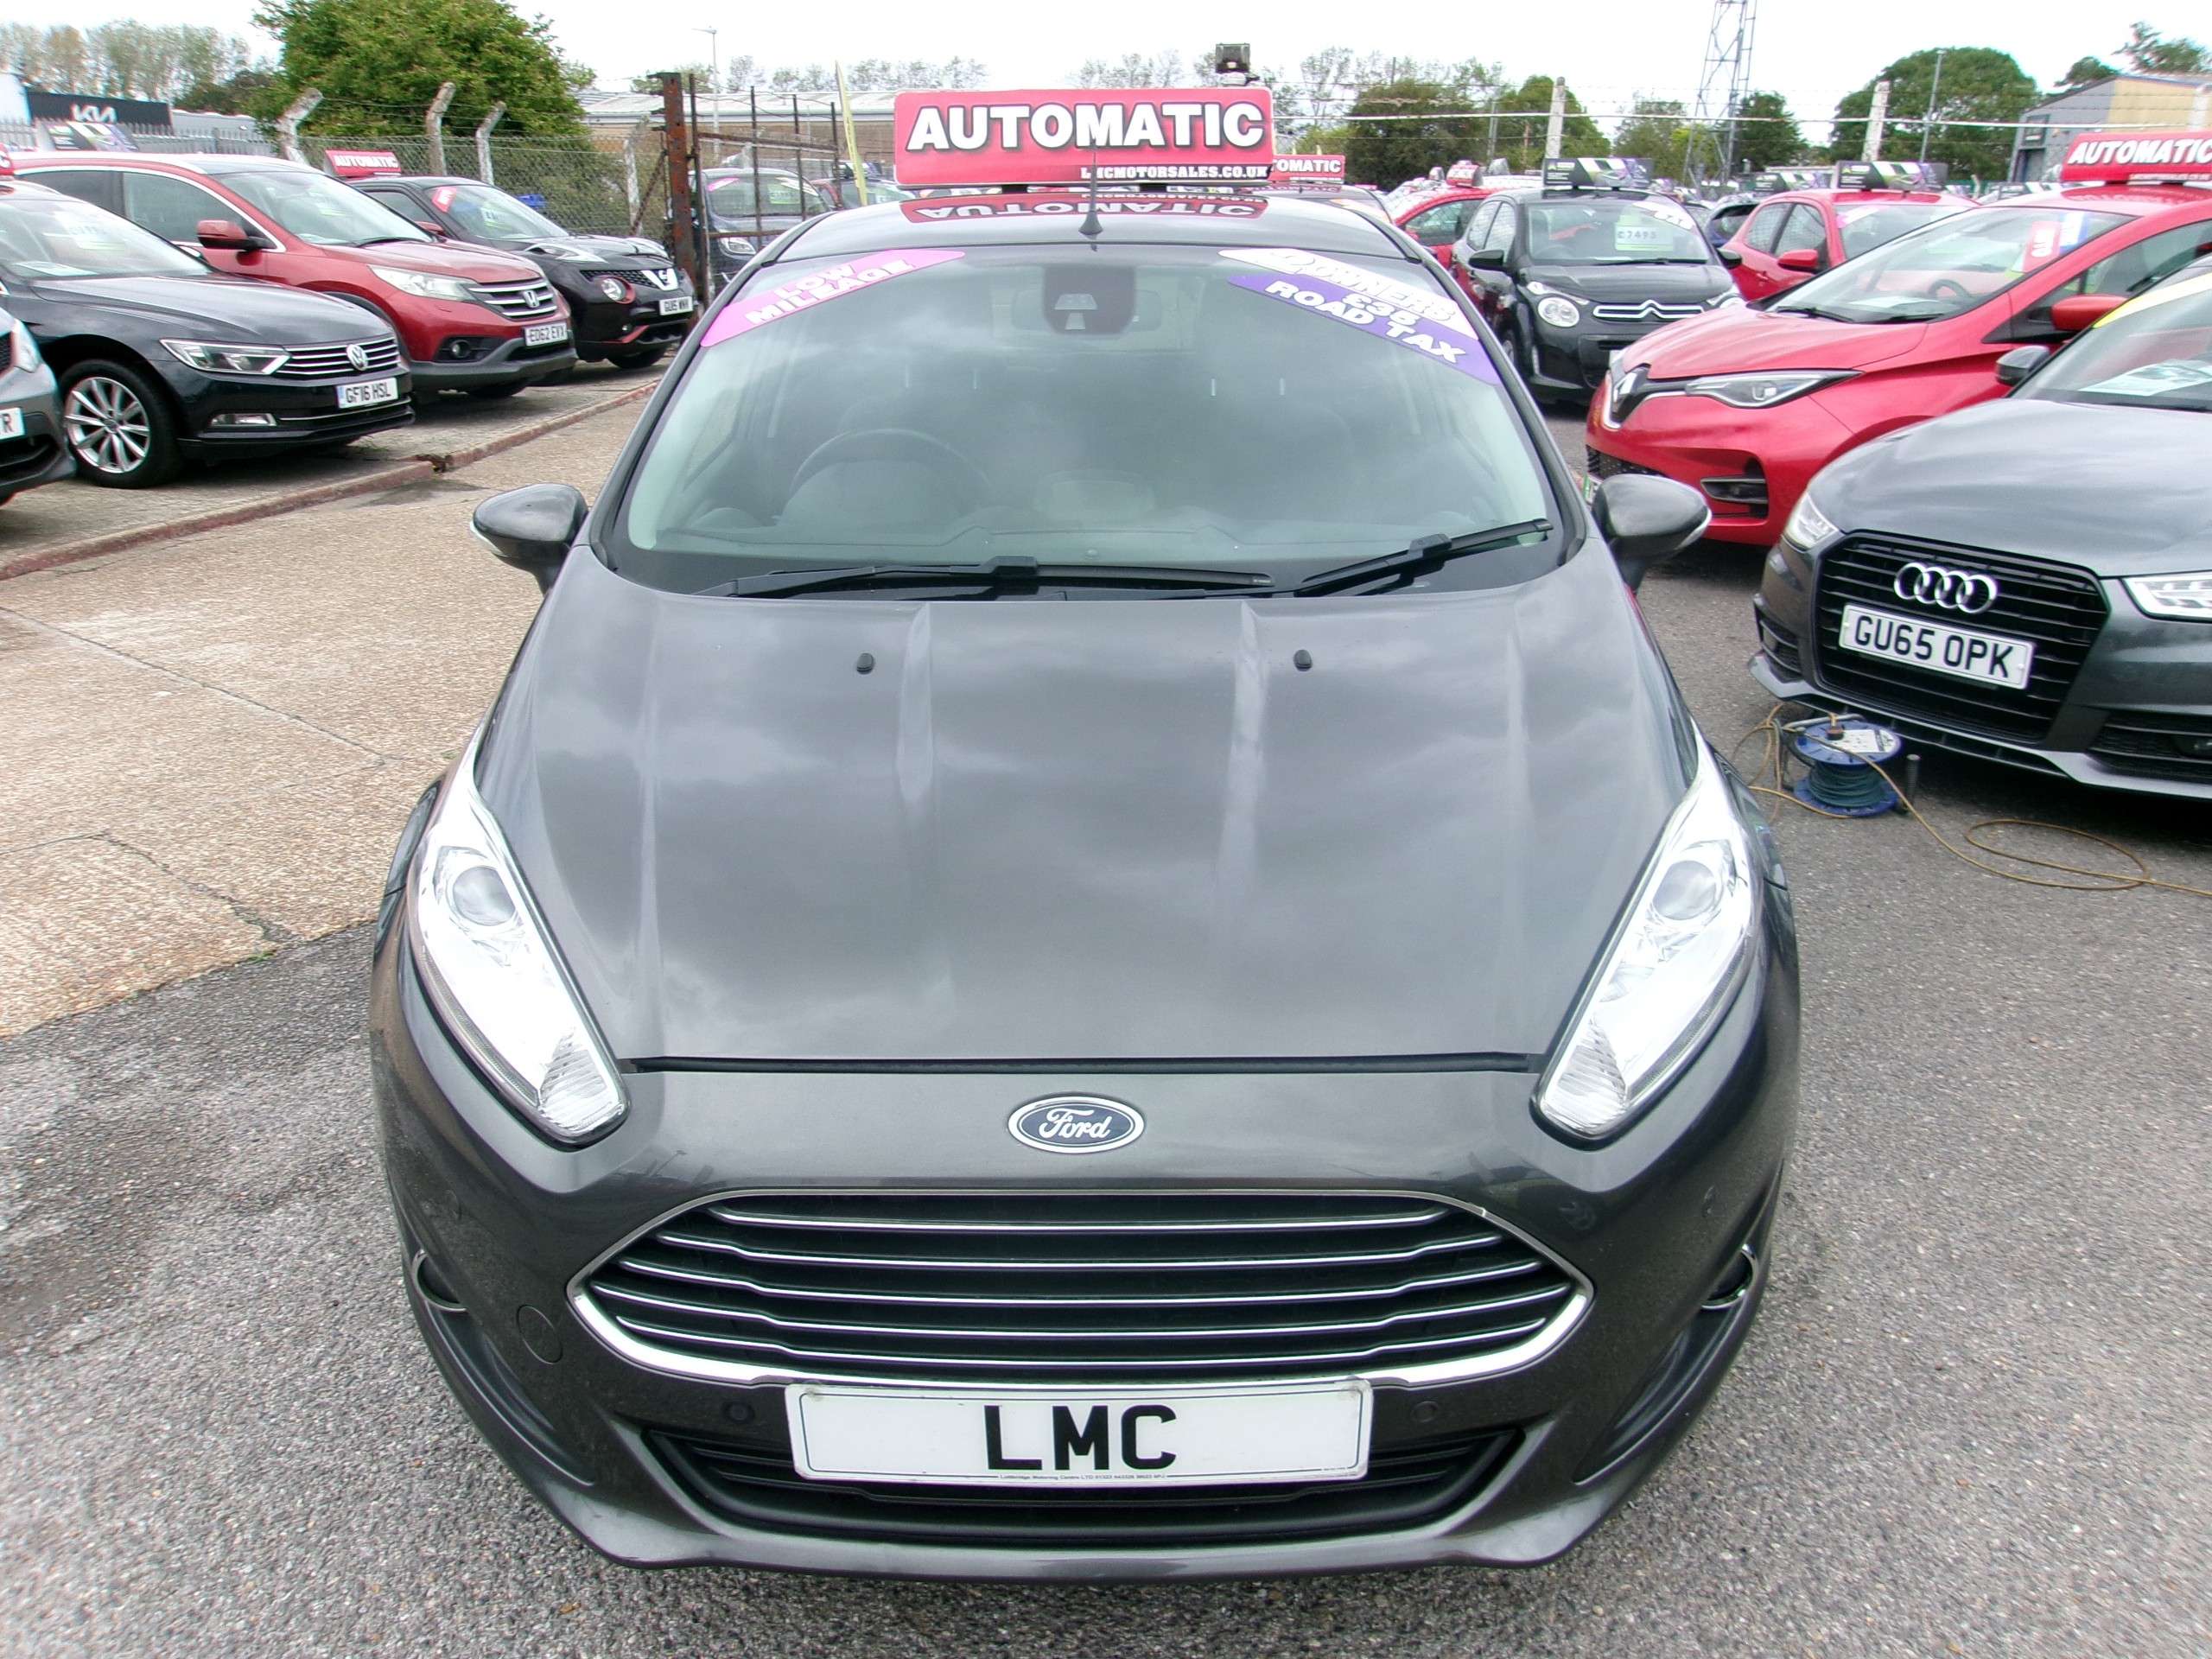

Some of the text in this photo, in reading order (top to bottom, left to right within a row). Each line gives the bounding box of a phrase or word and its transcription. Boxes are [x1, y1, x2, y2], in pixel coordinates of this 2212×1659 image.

[906, 101, 1266, 151] AUTOMATIC
[333, 155, 399, 168] AUTOMATIC
[2067, 138, 2212, 165] AUTOMATIC
[745, 258, 917, 326] MILEAGE
[774, 264, 856, 299] LOW
[1309, 261, 1458, 321] OWNERS
[1264, 280, 1466, 364] ROAD TAX
[346, 382, 391, 404] GF16 HSL
[1855, 615, 2014, 678] GU65 OPK
[1039, 1108, 1113, 1138] Ford
[984, 1404, 1177, 1470] LMC
